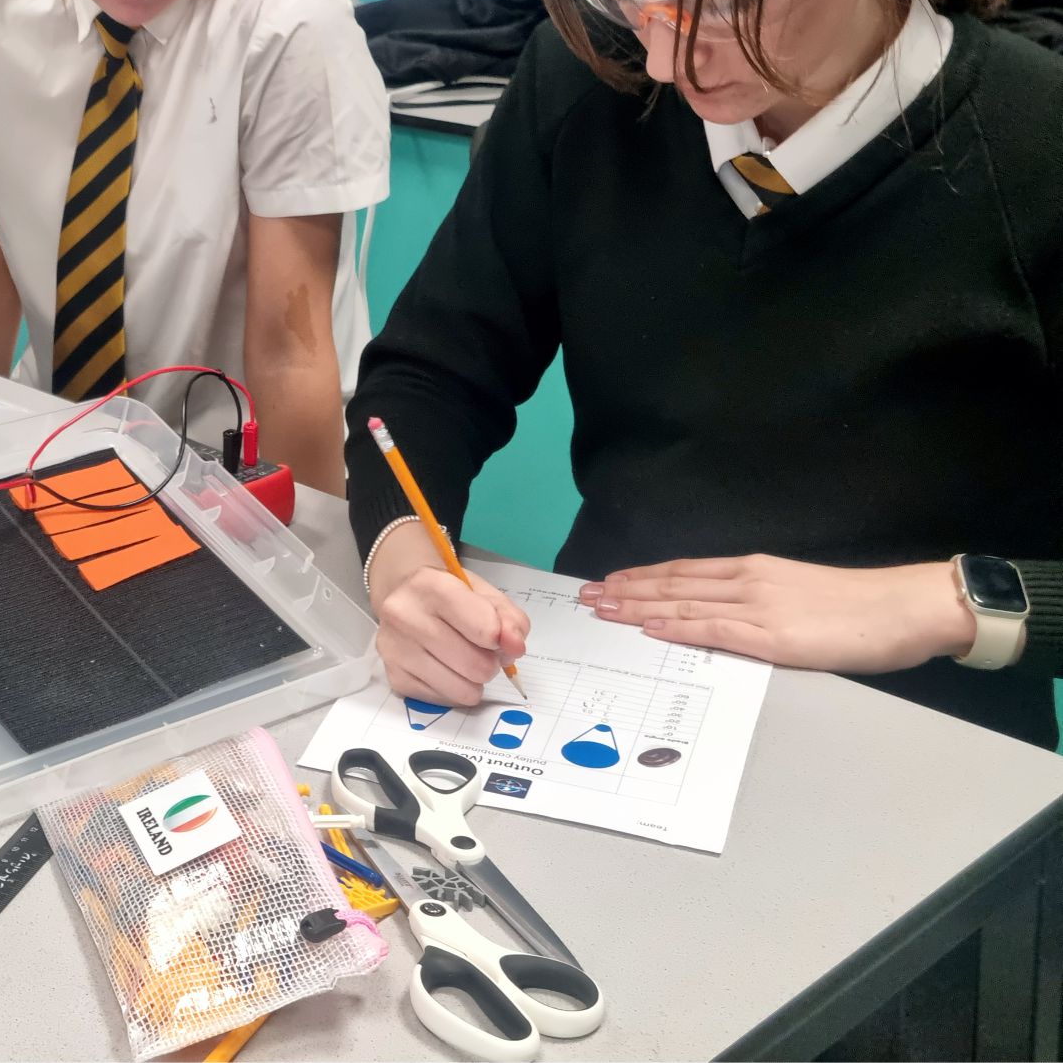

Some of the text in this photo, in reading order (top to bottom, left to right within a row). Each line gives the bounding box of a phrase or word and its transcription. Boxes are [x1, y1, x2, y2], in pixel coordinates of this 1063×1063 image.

[439, 740, 512, 759] combinations
[487, 758, 544, 776] Output
[514, 754, 547, 766] pulley
[136, 807, 173, 856] IRELAND
[636, 820, 667, 831] Team:
